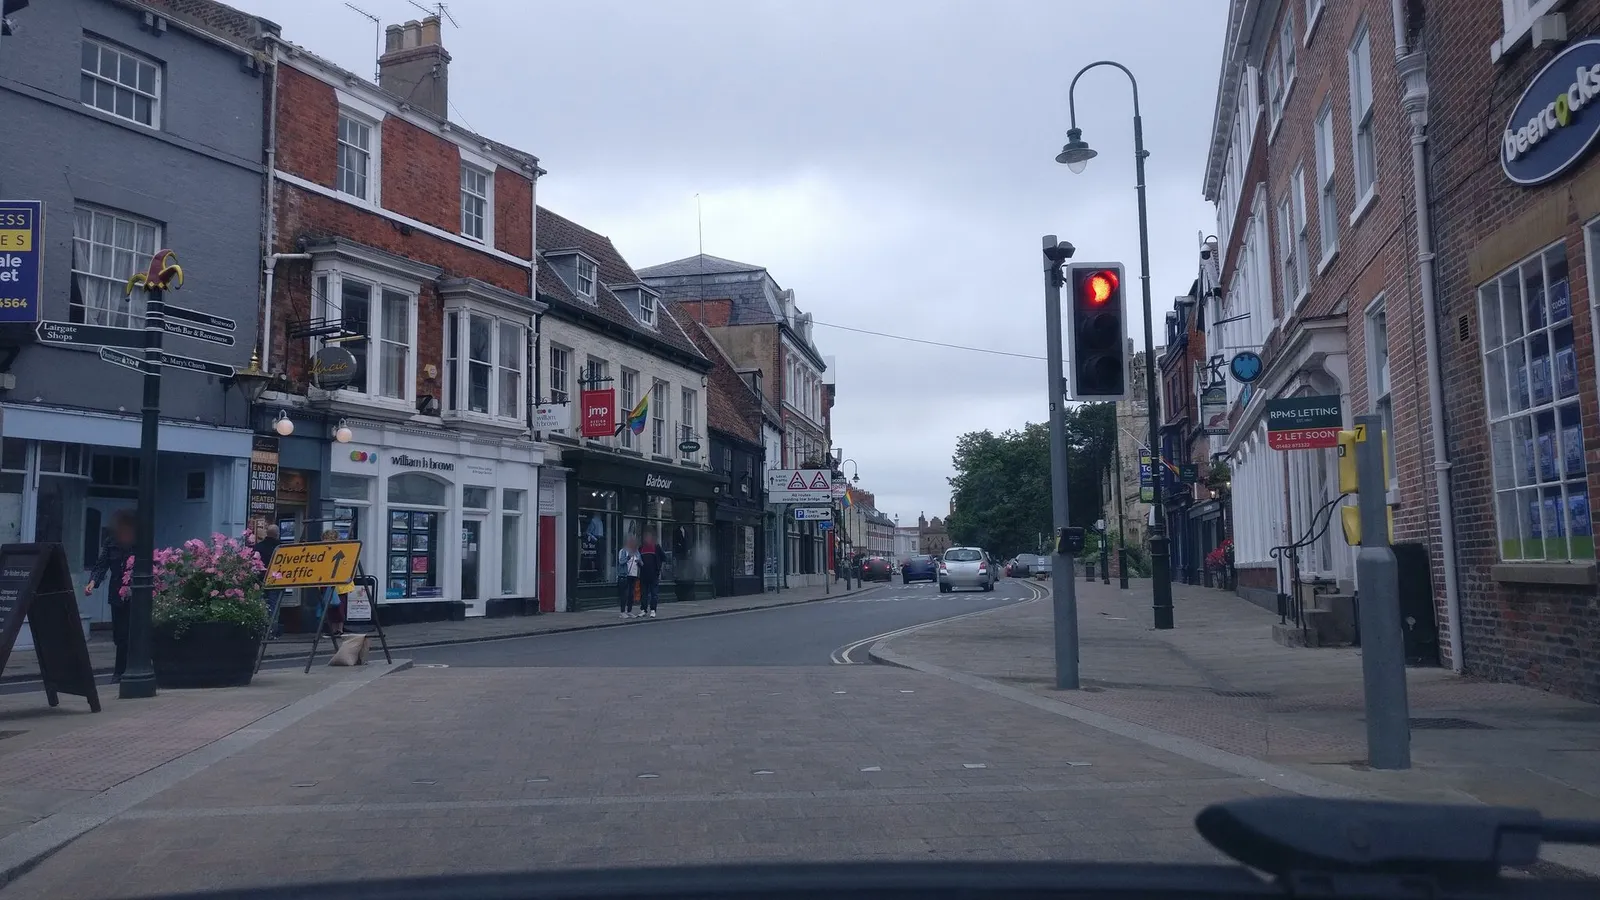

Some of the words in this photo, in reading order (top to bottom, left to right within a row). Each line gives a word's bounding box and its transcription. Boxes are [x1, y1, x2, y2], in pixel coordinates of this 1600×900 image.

[1505, 63, 1600, 163] beercocks
[44, 323, 77, 333] Lairgate
[210, 318, 234, 328] Westwood
[47, 332, 72, 342] Shops
[164, 324, 182, 333] North
[183, 328, 192, 336] Bar
[200, 331, 228, 342] Racecourse
[170, 358, 186, 367] Mary's
[188, 361, 206, 370] Church
[588, 406, 608, 418] jmp
[1270, 410, 1296, 419] RPMS
[1298, 407, 1338, 417] LETTING
[1284, 432, 1302, 440] LET
[1306, 430, 1335, 439] SOON
[1356, 427, 1363, 439] 7
[392, 455, 421, 468] william
[429, 458, 454, 471] brown
[259, 472, 275, 480] FRESCO
[646, 474, 672, 489] Barbour
[252, 480, 275, 491] DINING
[274, 551, 326, 565] Diverted
[276, 567, 313, 579] traffic
